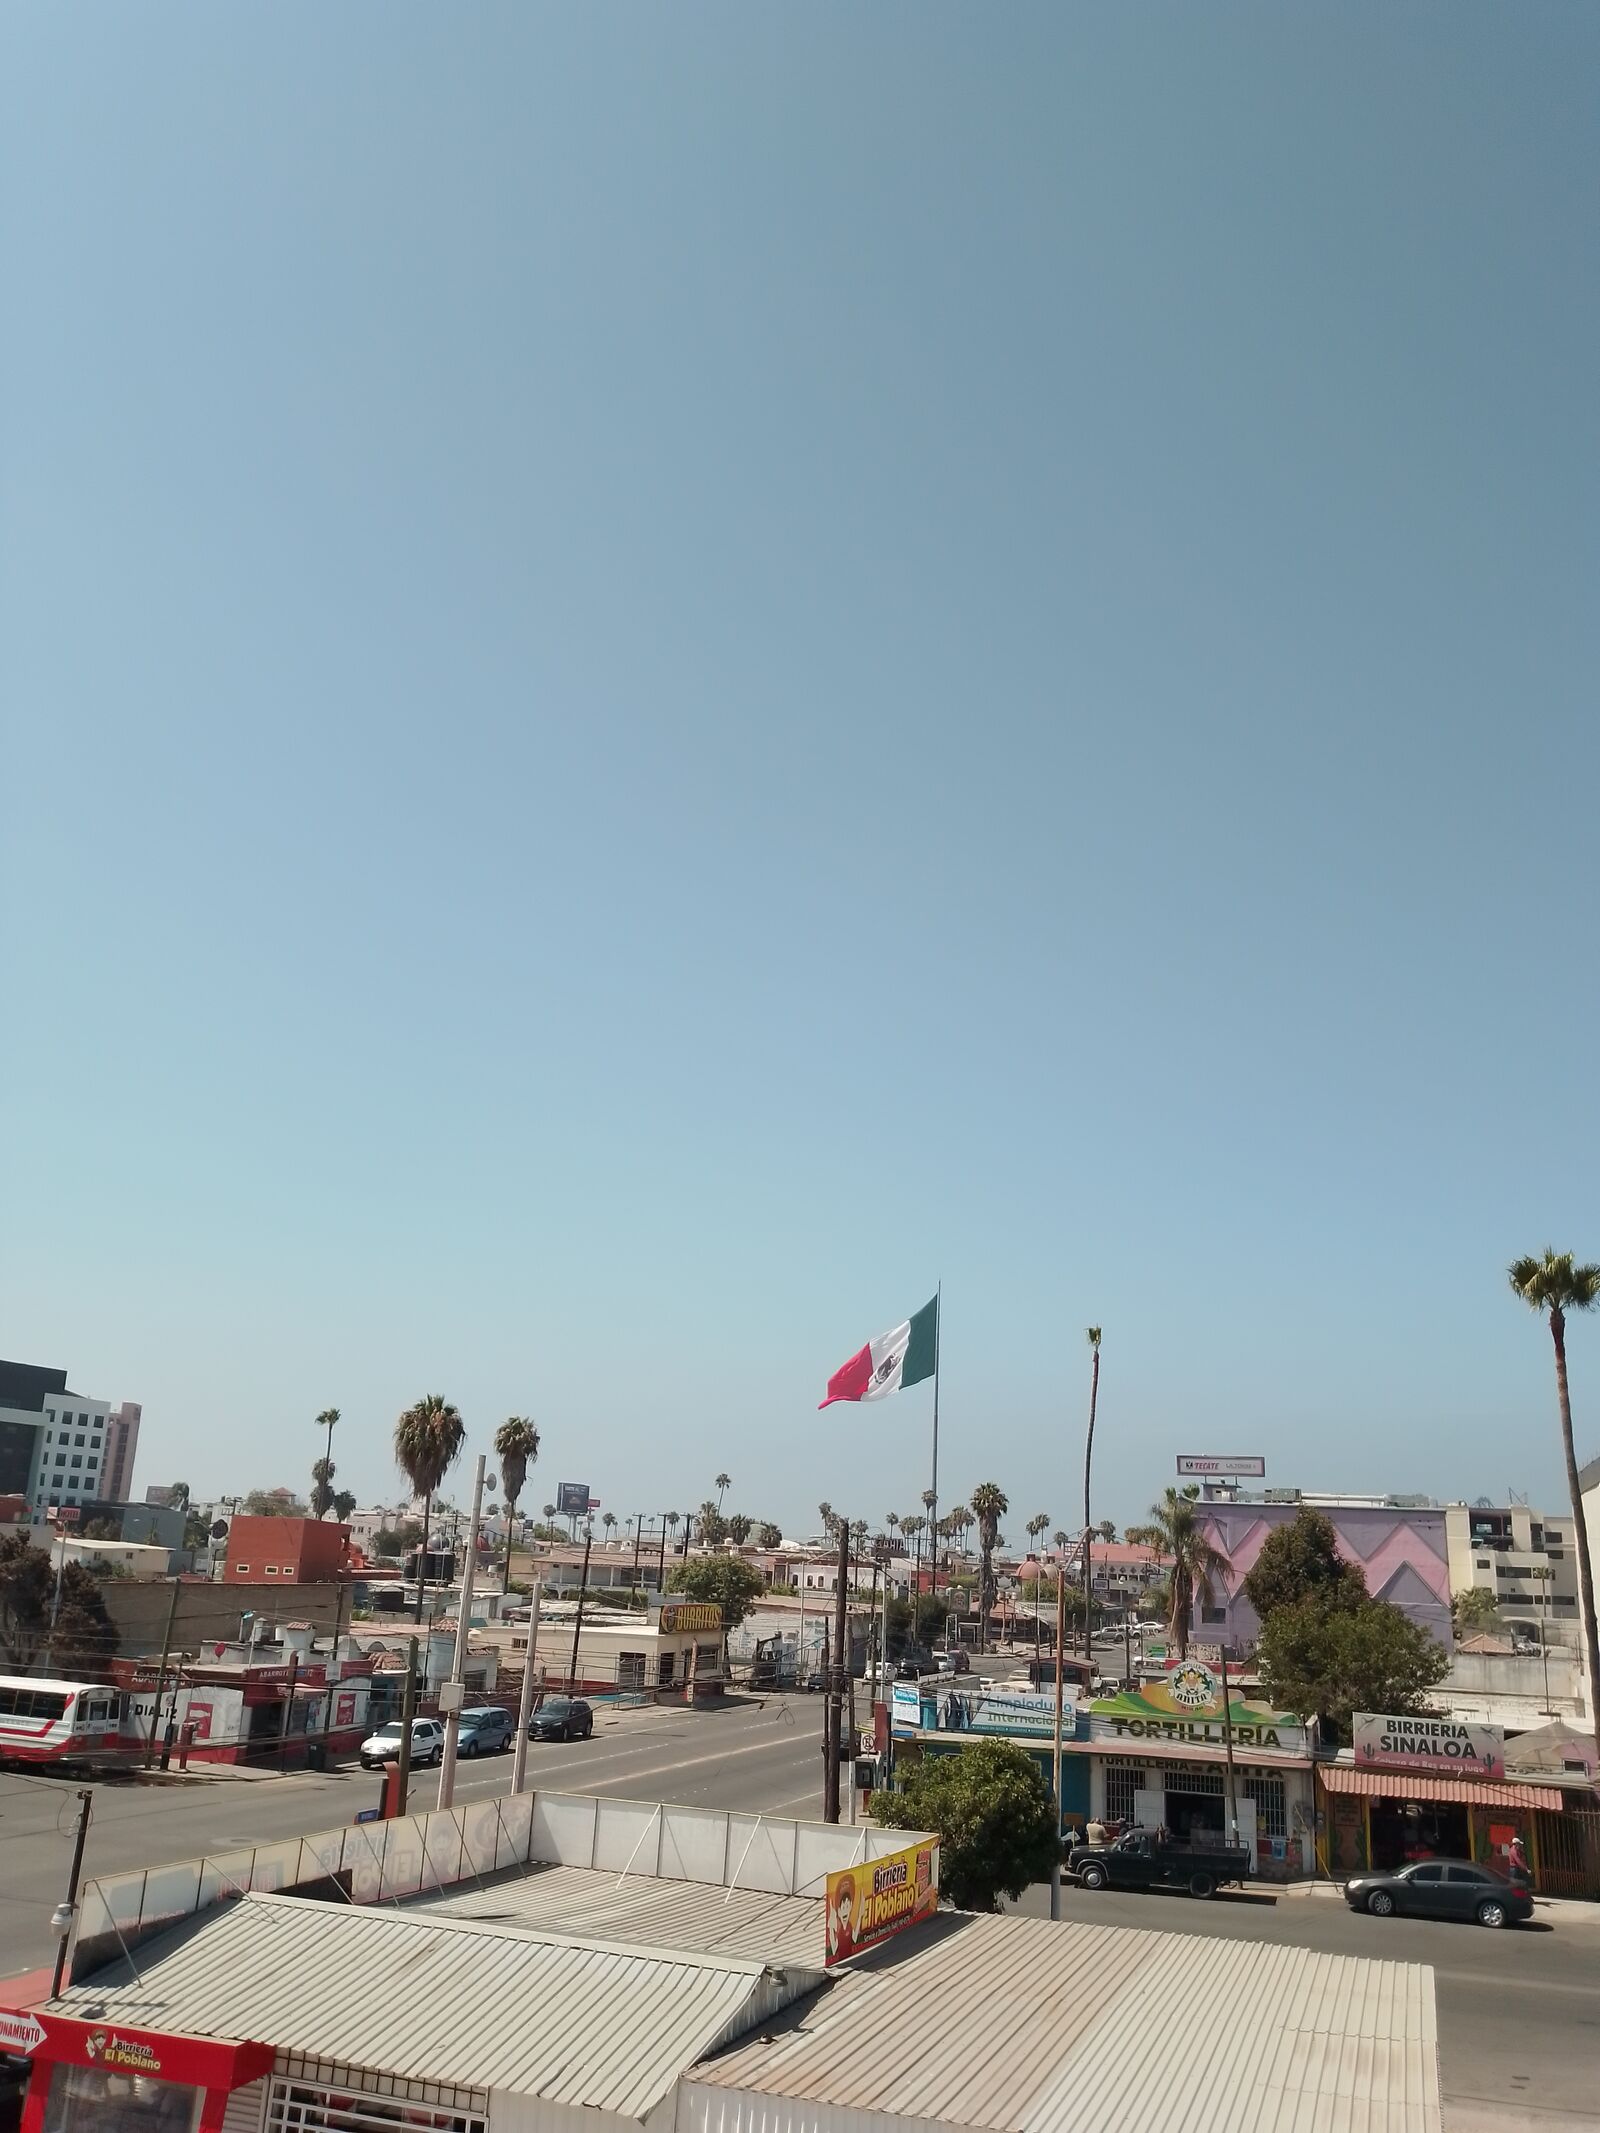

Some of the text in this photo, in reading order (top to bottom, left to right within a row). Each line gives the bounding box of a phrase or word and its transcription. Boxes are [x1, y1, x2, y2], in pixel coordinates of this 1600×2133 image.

[1194, 1462, 1219, 1470] TECATE
[676, 1606, 721, 1631] BURRITOS
[1386, 1720, 1469, 1739] BIRRIERIA
[1380, 1735, 1477, 1759] SINALOA
[861, 1897, 874, 1931] El
[874, 1886, 914, 1923] Poblano
[105, 2049, 161, 2070] El Poblano
